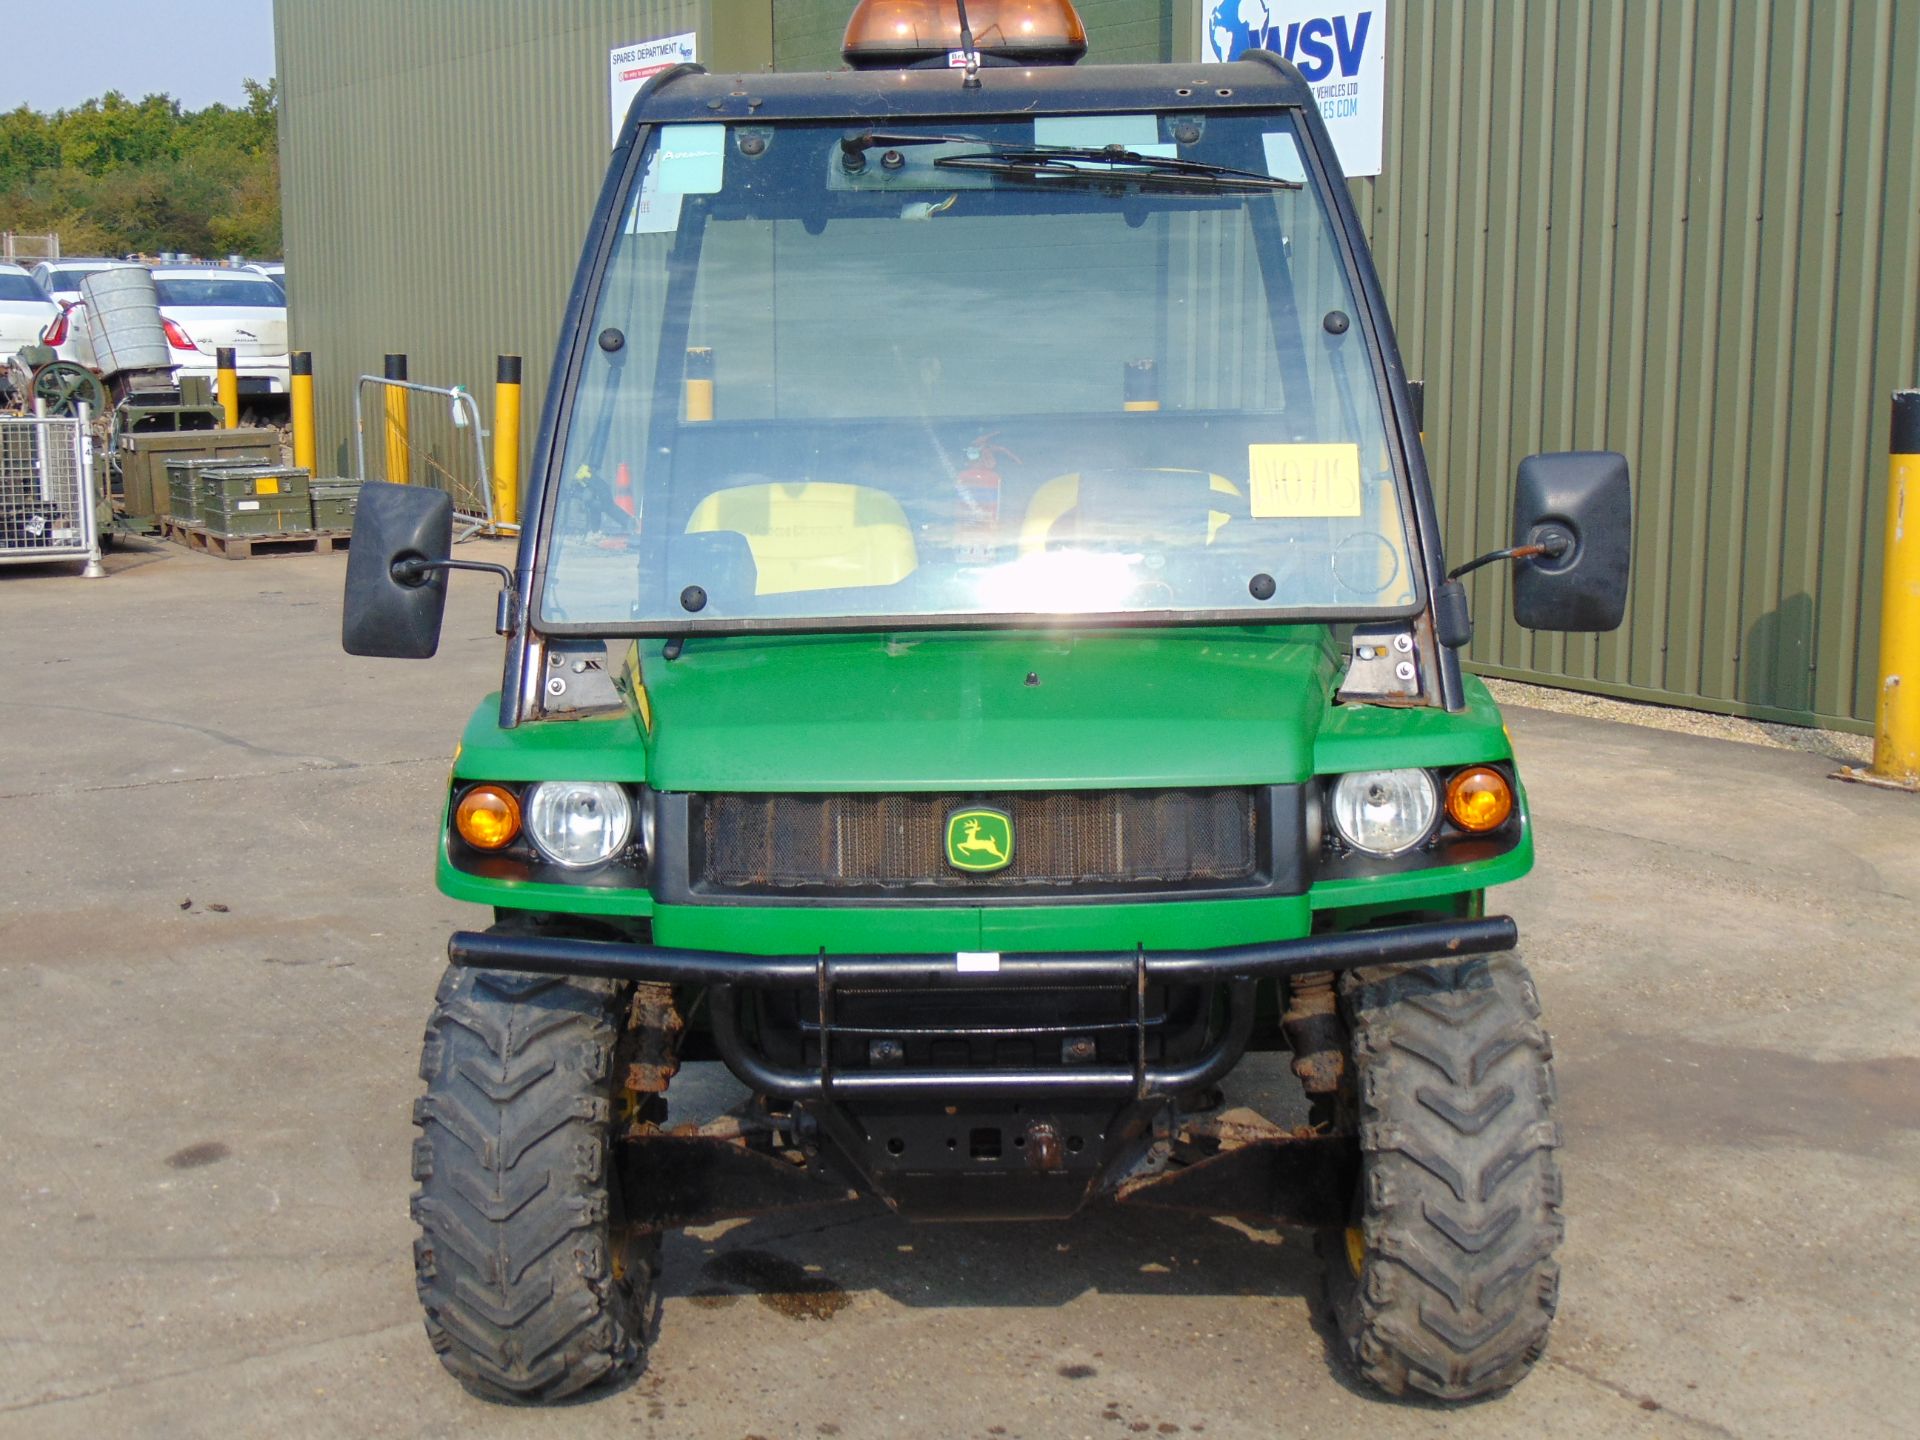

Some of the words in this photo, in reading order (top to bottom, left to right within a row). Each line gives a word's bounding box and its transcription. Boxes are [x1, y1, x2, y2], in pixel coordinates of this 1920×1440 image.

[612, 50, 635, 65] SPARES
[637, 42, 677, 60] DEPARTMENT
[1316, 83, 1346, 99] VEHICLES
[1347, 82, 1358, 96] LTD
